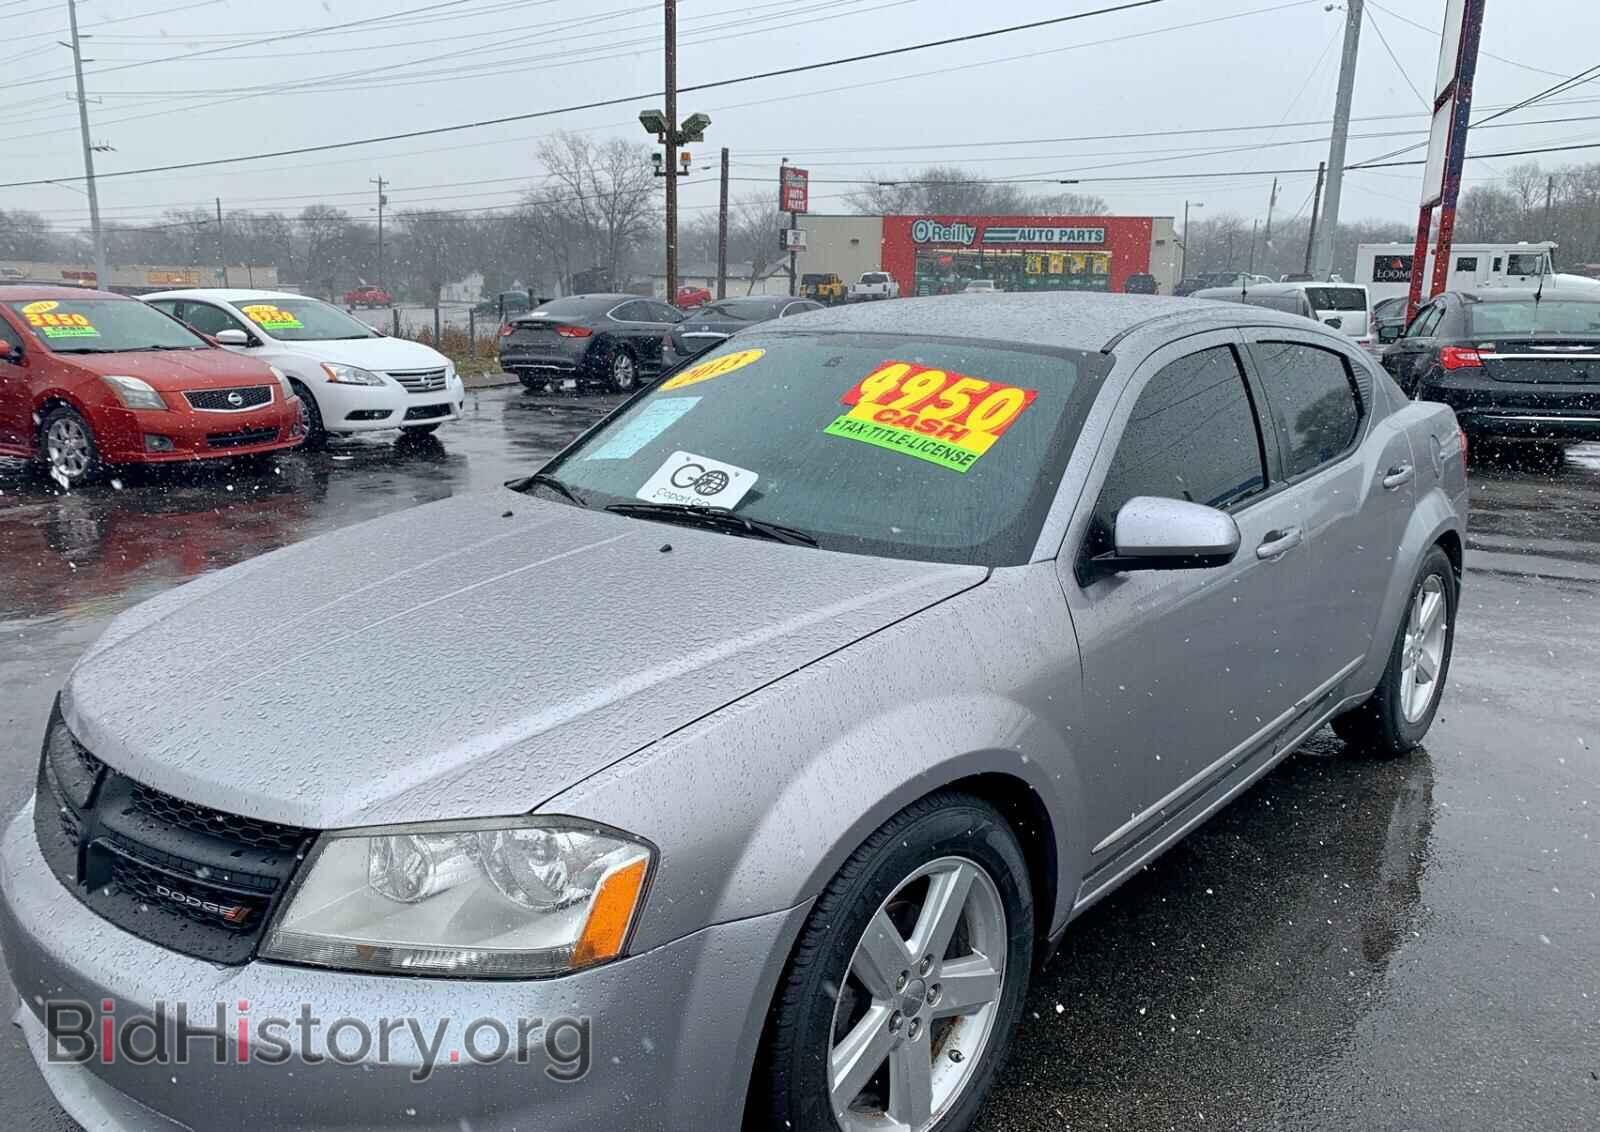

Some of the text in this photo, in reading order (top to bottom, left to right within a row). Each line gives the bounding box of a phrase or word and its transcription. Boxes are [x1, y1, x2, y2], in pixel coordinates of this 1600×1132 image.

[914, 221, 976, 244] O'Reilly
[1018, 229, 1103, 242] AUTO PARTS
[858, 363, 1026, 432] 4950
[872, 408, 970, 441] CASH
[157, 885, 238, 914] DODGE
